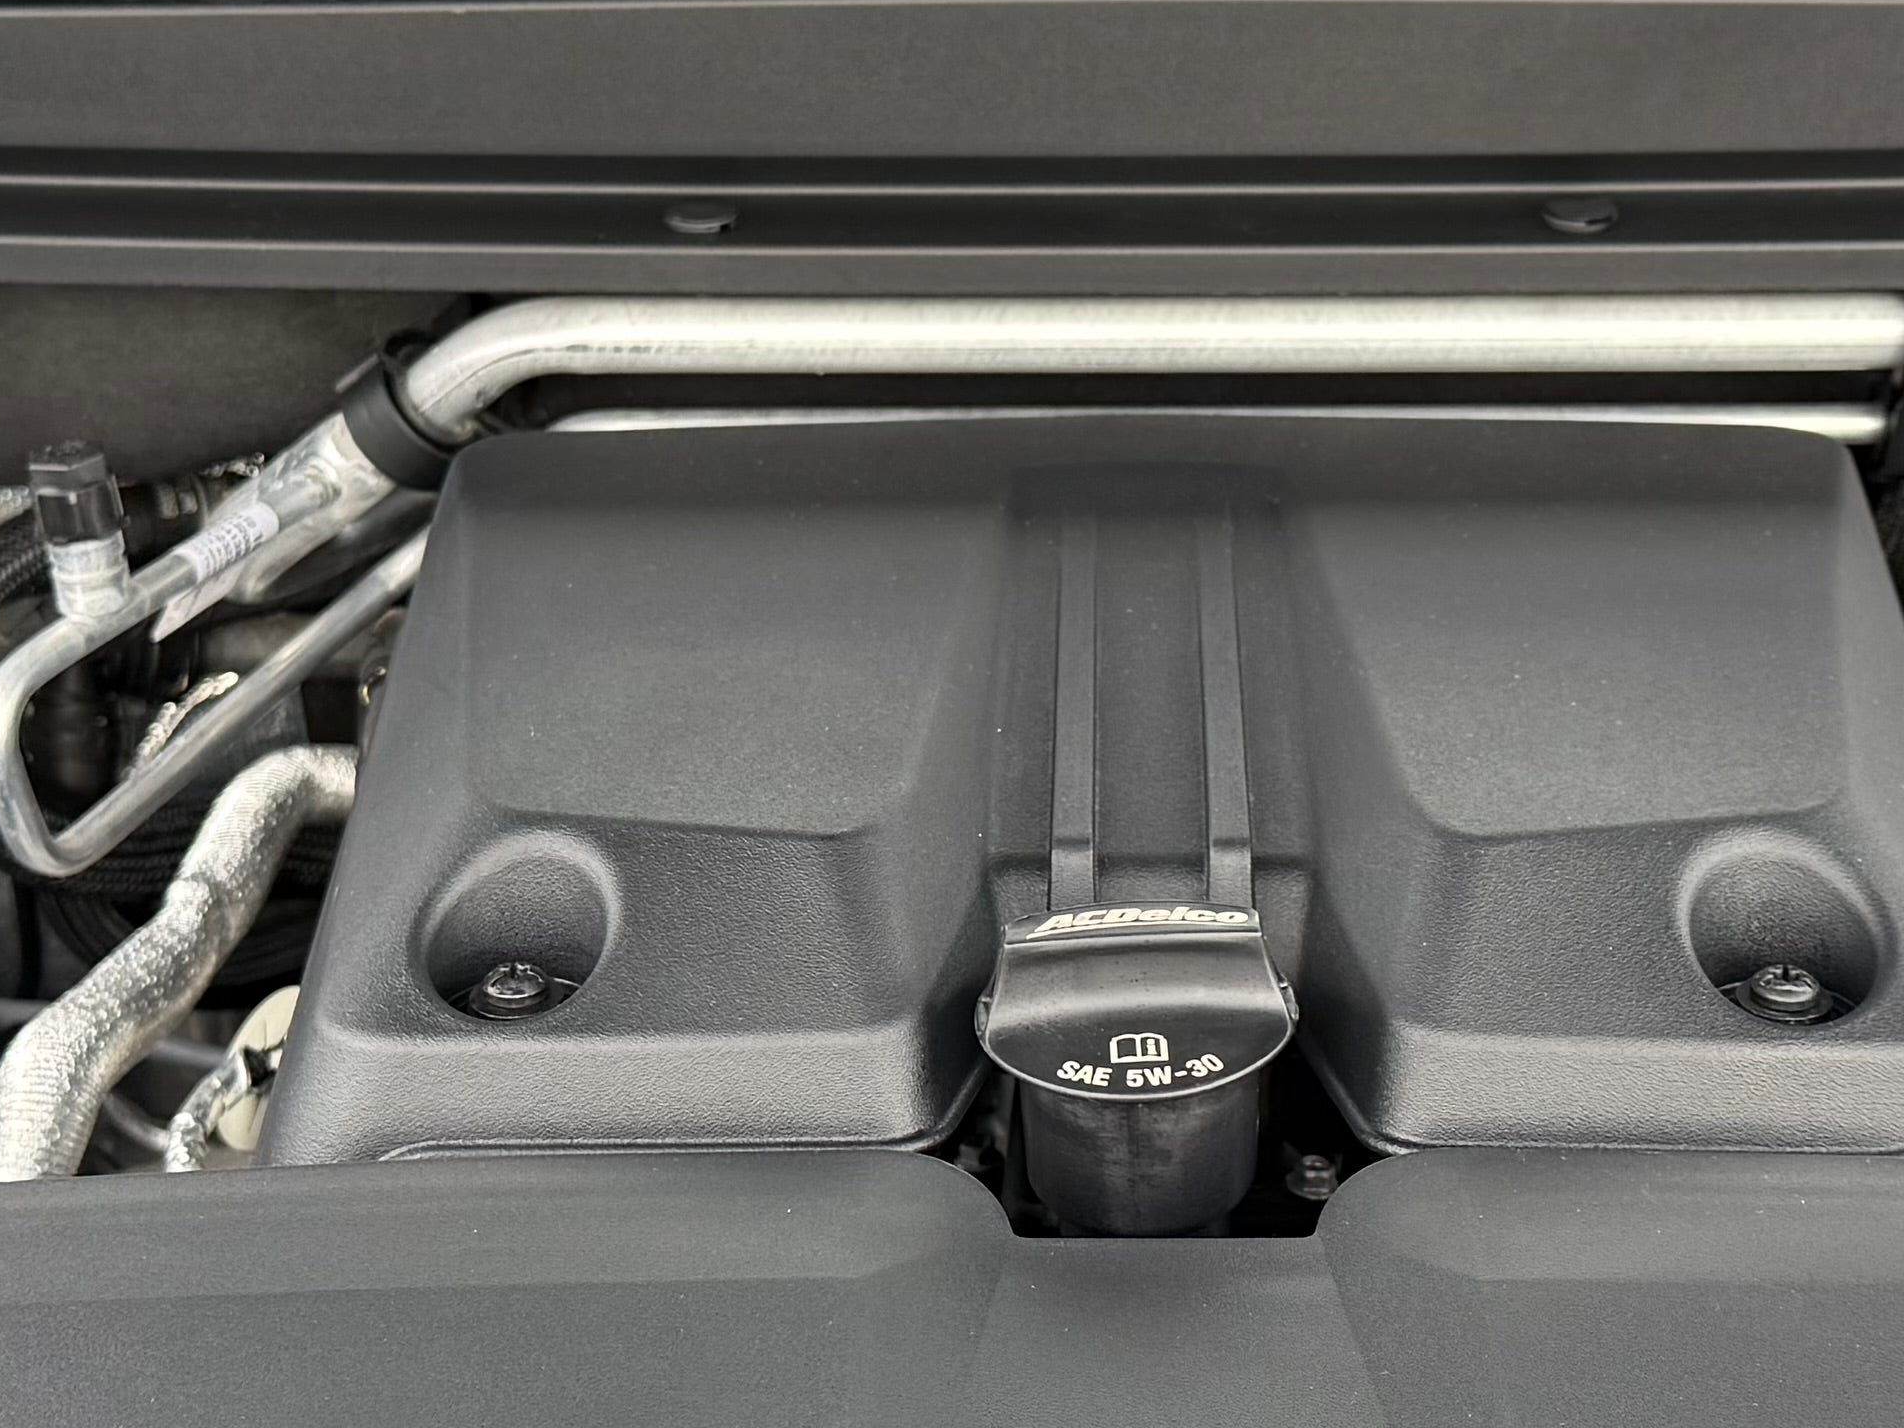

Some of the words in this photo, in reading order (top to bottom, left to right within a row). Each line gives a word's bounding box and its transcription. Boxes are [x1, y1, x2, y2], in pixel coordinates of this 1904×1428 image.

[1034, 906, 1250, 934] ACDelco
[1056, 1059, 1113, 1087] SAE
[1125, 1052, 1225, 1089] 5W-30
